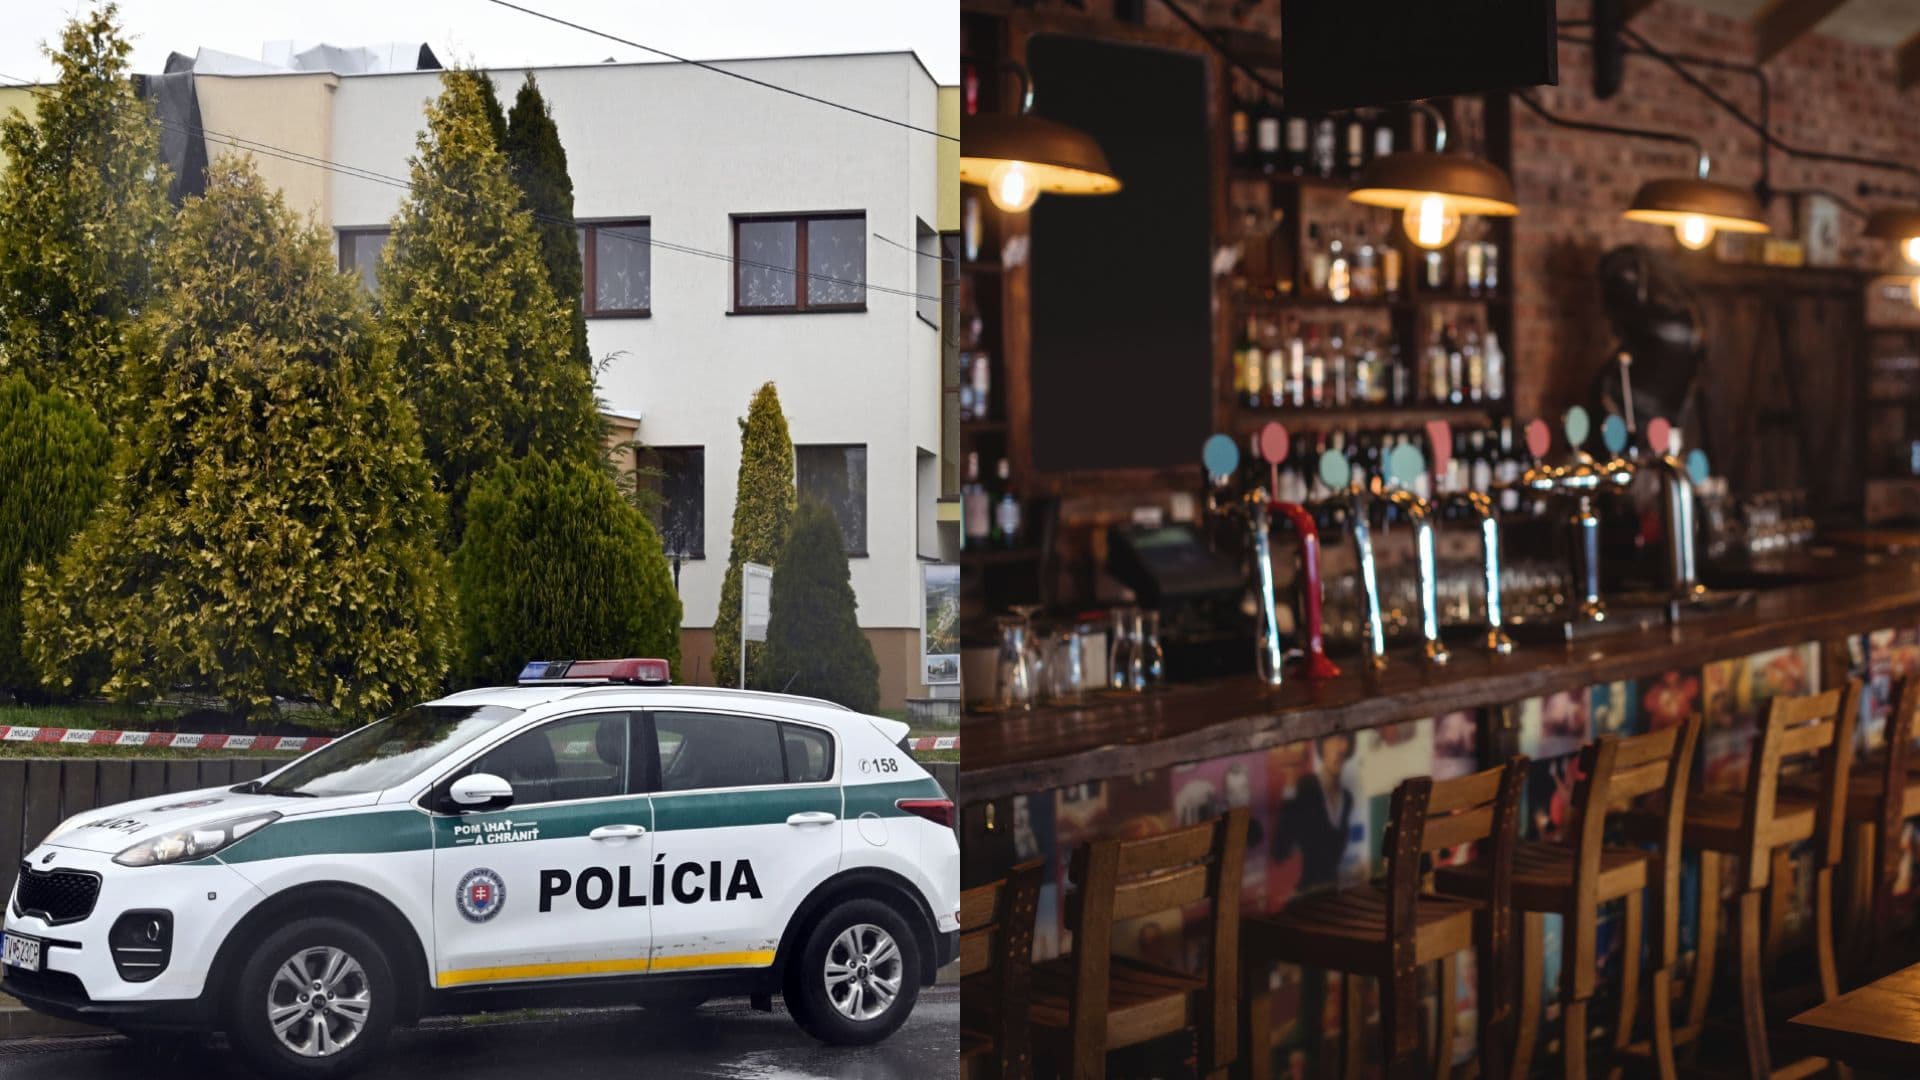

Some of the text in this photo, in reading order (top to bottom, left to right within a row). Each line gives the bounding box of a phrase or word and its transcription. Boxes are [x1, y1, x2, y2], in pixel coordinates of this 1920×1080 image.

[872, 758, 898, 773] 158
[475, 834, 484, 845] A
[539, 853, 763, 912] POLÍCIA
